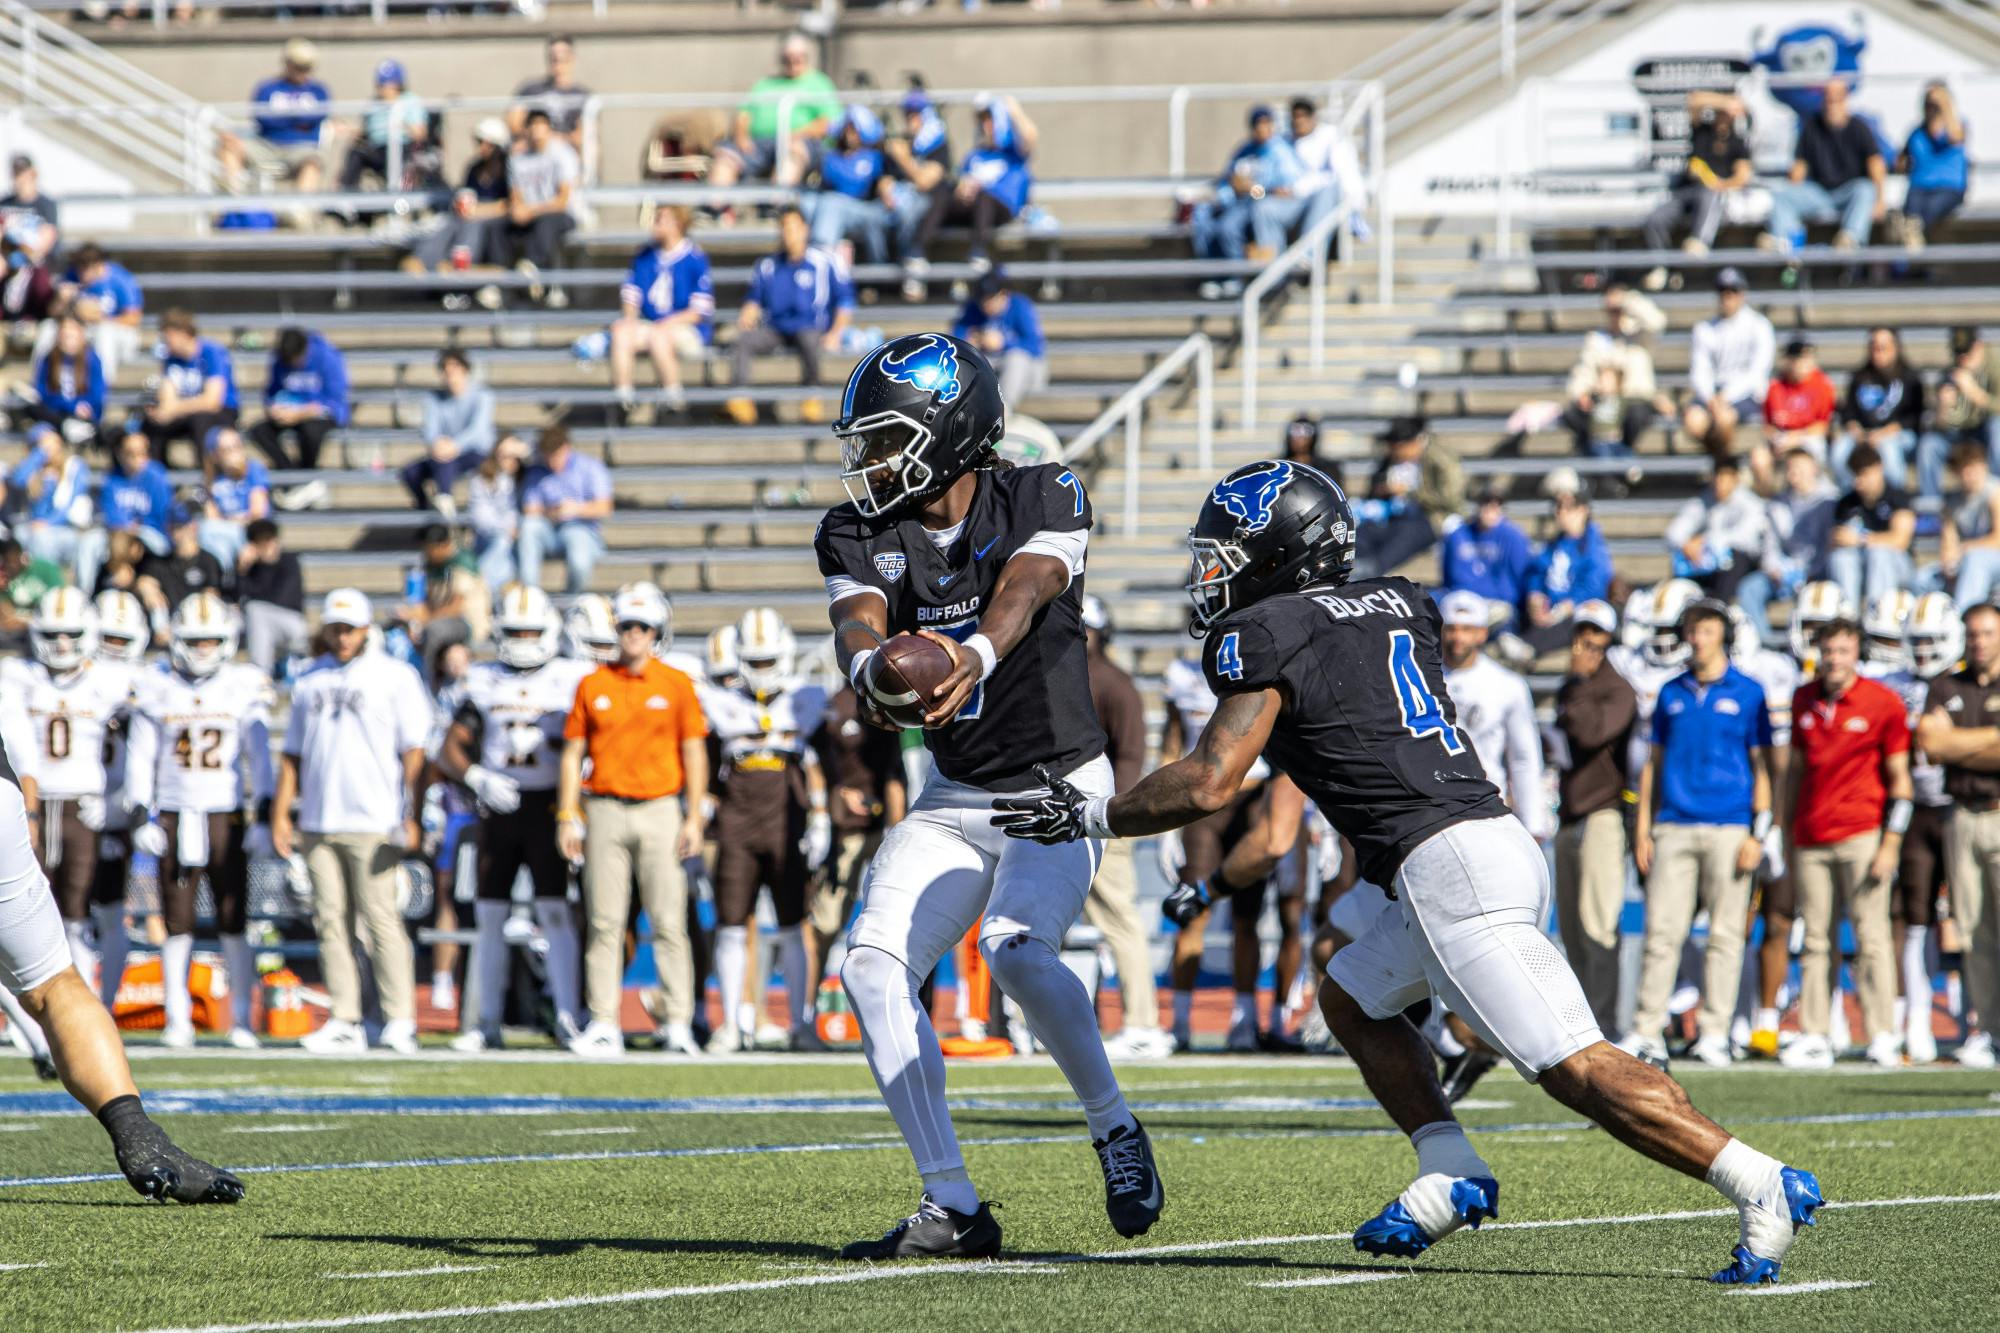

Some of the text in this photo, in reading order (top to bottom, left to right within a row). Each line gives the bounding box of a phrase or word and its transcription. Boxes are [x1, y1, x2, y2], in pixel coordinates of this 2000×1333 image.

[1055, 470, 1084, 517] 7
[877, 560, 906, 570] MAC
[917, 595, 980, 621] BUFFALO
[1216, 631, 1243, 681] 4
[1388, 629, 1467, 757] 4
[48, 715, 71, 760] 0
[175, 727, 222, 769] 42
